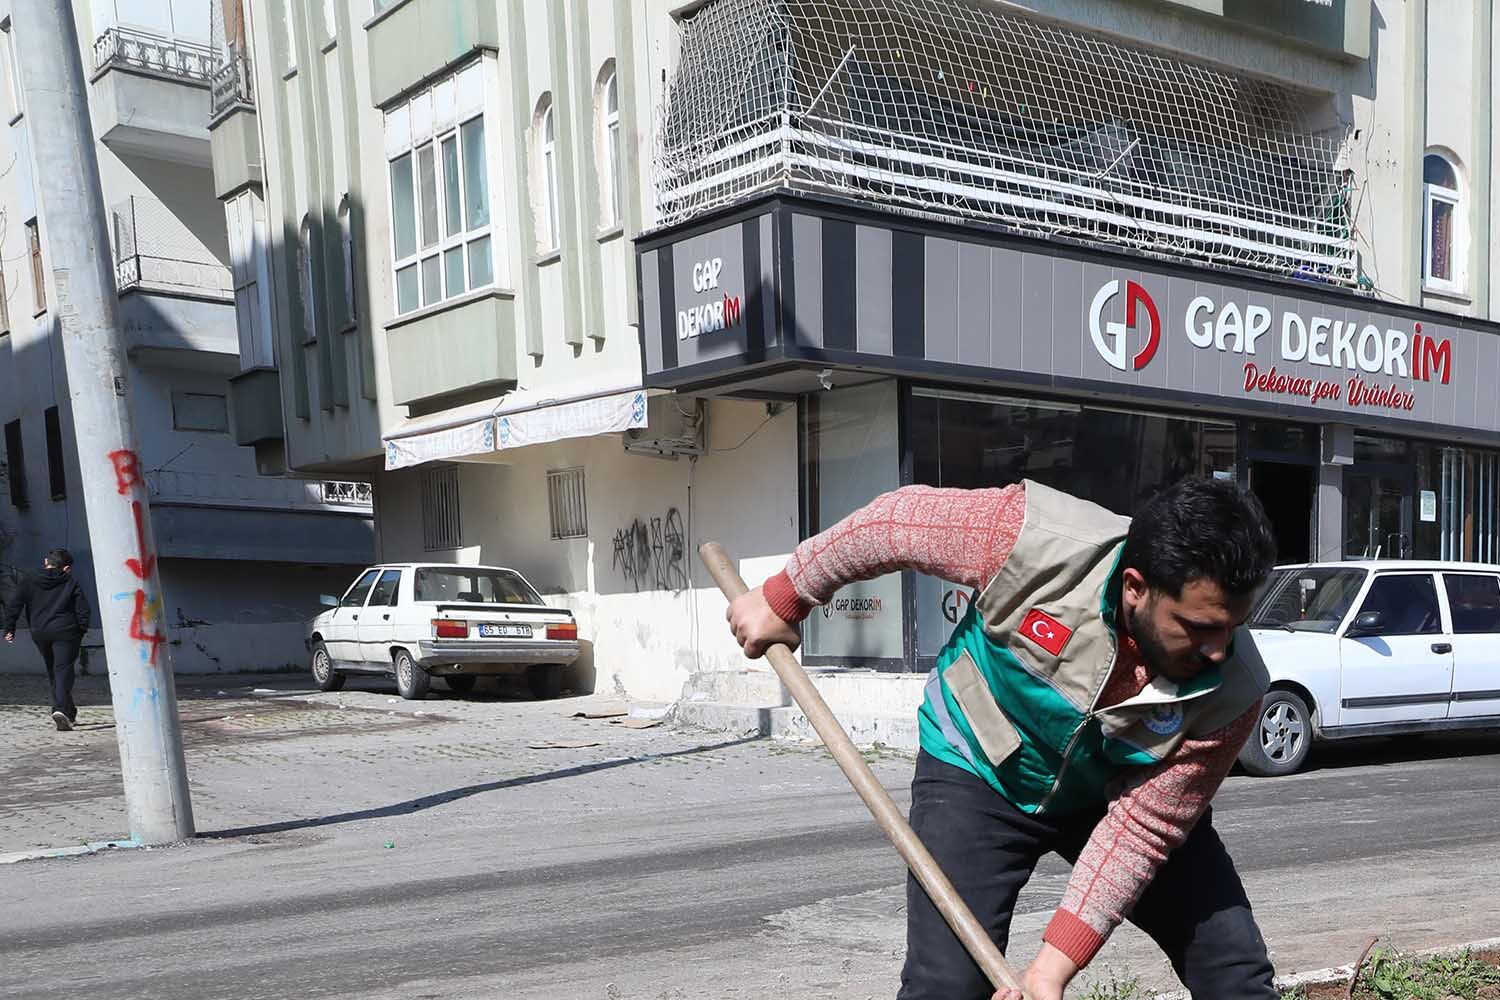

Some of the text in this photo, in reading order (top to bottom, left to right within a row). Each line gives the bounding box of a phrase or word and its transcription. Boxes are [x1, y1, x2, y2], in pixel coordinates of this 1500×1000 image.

[692, 257, 722, 293] GAP
[678, 291, 741, 340] DEKORİM
[1089, 279, 1161, 371] GD
[1184, 296, 1452, 385] GAP DEKORİM
[1243, 362, 1416, 411] Dekorasyon Ürünleri
[835, 599, 849, 611] GAP
